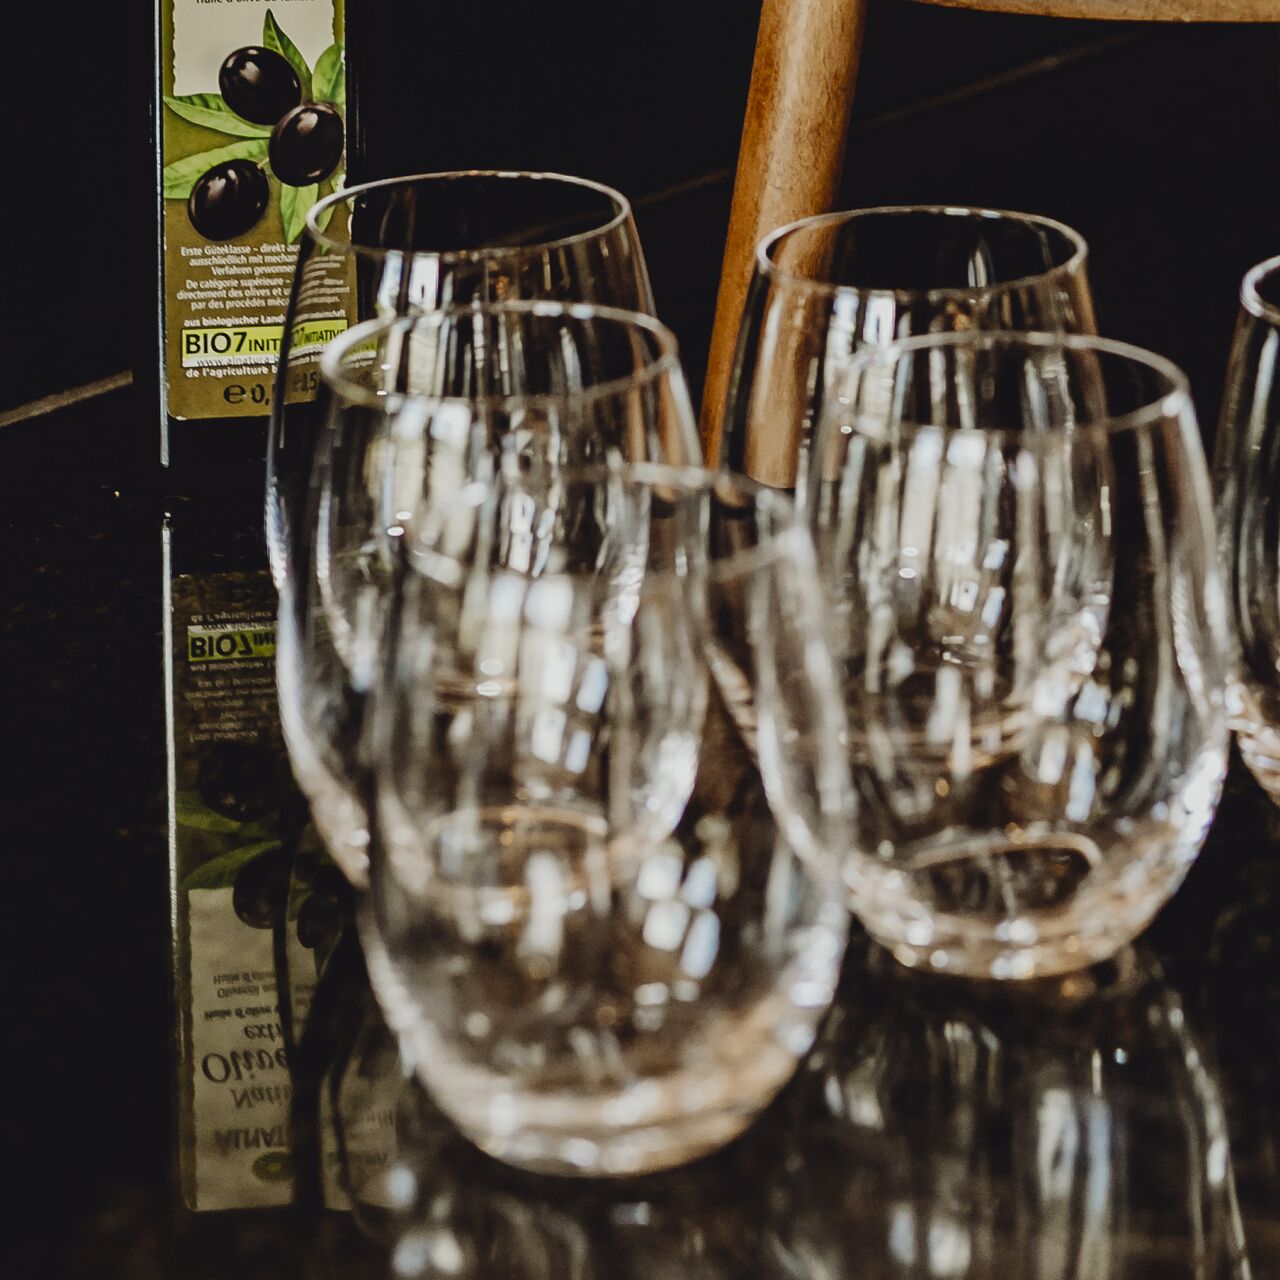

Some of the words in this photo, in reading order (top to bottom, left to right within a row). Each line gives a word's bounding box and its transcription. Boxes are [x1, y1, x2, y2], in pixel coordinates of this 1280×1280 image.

[181, 246, 203, 257] Erste
[260, 243, 286, 254] direkt
[248, 255, 263, 263] mit
[264, 254, 298, 263] mechan
[185, 279, 198, 289] De
[228, 288, 244, 298] des
[272, 287, 282, 296] et
[207, 300, 224, 309] des
[184, 318, 200, 327] aus
[202, 315, 260, 327] biologischer
[185, 368, 200, 378] de
